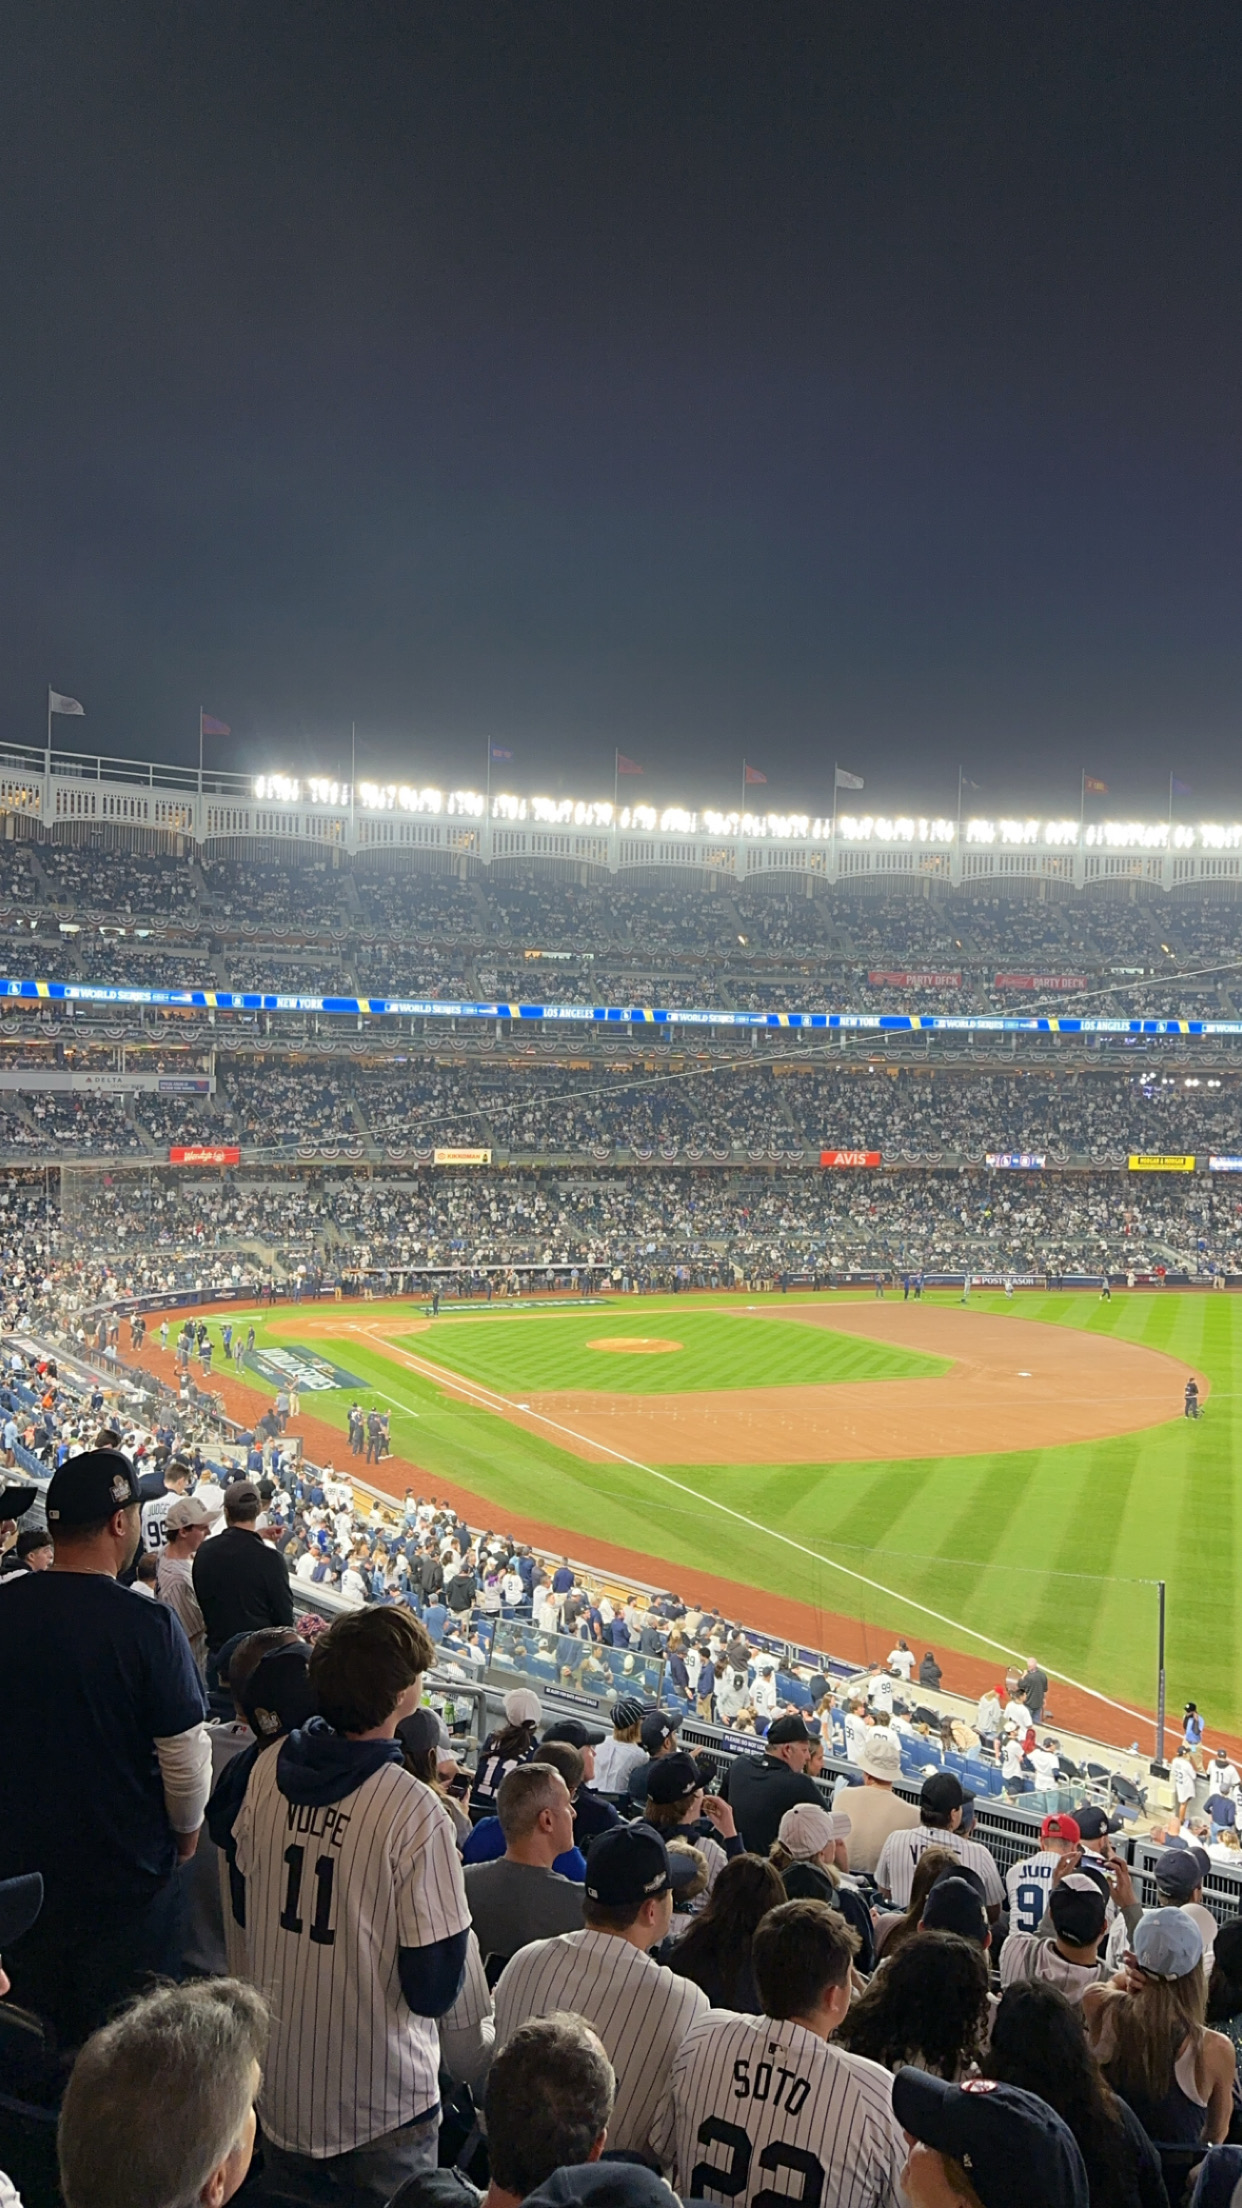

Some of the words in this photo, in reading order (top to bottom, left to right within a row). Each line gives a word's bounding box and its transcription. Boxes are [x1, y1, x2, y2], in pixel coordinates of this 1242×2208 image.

[906, 975, 932, 985] PARTY
[935, 976, 959, 986] DECK
[1033, 977, 1060, 988] PARTY
[1062, 978, 1085, 988] DECK
[80, 989, 116, 999] WORLD
[118, 990, 151, 1001] SERIES
[277, 997, 298, 1009] NEW
[299, 998, 323, 1009] YORK
[398, 1004, 431, 1014] WORLD
[433, 1005, 461, 1015] SERIES
[543, 1009, 557, 1018] LOS
[559, 1009, 594, 1019] ANGELES
[679, 1013, 708, 1022] WORLD
[709, 1014, 735, 1024] SERIES
[839, 1017, 857, 1026] NEW
[859, 1017, 880, 1027] YORK
[947, 1019, 976, 1029] WORLD
[978, 1021, 1004, 1030] SERIES
[1080, 1021, 1094, 1030] LOS
[1096, 1021, 1130, 1031] ANGELES
[834, 1153, 866, 1165] AVIS
[881, 1682, 891, 1694] 99
[1216, 1771, 1224, 1781] 11
[287, 1801, 351, 1847] VOLPE
[1019, 1865, 1052, 1879] JUD
[280, 1843, 335, 1945] 11
[1017, 1884, 1051, 1933] 9
[734, 2060, 811, 2116] SOTO
[690, 2115, 825, 2208] 22
